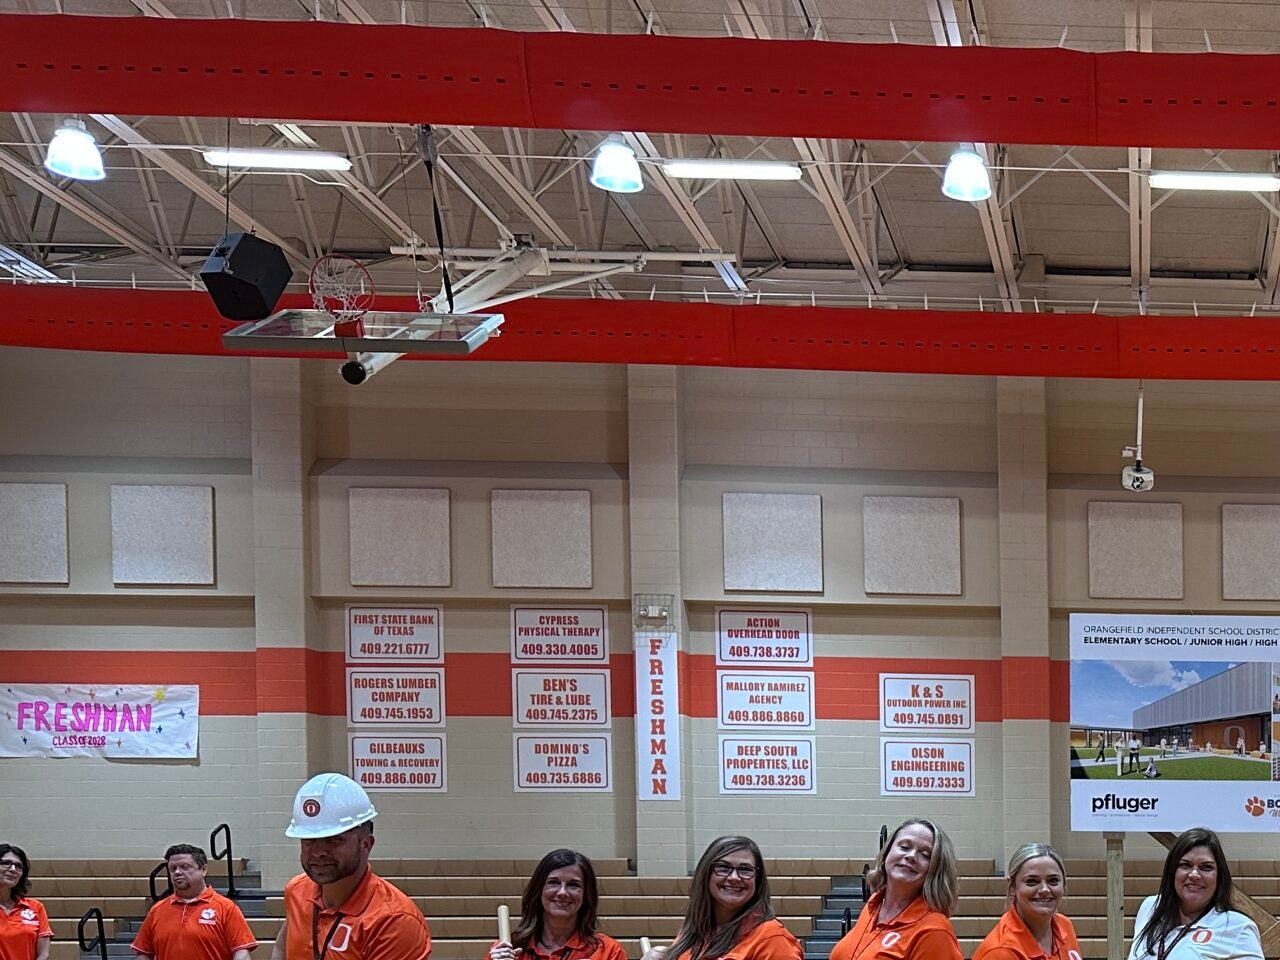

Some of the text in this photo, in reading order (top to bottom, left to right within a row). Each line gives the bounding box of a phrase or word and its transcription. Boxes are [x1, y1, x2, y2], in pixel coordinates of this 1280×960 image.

[354, 615, 434, 625] FIRST STATE BANK
[539, 615, 579, 625] CYPRESS
[746, 618, 780, 628] ACTION
[374, 626, 414, 636] OF TEXAS
[518, 627, 600, 637] PHYSICAL THERAPY
[727, 629, 800, 640] OVERHEAD DOOR
[1083, 625, 1144, 634] ORANGEFIELD
[1147, 626, 1206, 635] INDEPENDENT
[1208, 627, 1244, 635] SCHOOL
[1083, 636, 1143, 645] ELEMENTARY
[1145, 637, 1182, 645] SCHOOL
[1189, 638, 1223, 646] JUNIOR
[1225, 638, 1248, 646] HIGH
[1255, 639, 1278, 647] HIGH
[360, 643, 429, 655] 409.221.6777
[522, 643, 598, 656] 409.330.4005
[729, 645, 800, 658] 409.738.3737
[354, 678, 437, 689] ROGERS LUMBER
[543, 679, 578, 692] BEN'S
[726, 682, 805, 693] MALLORY RAMIREZ
[911, 684, 944, 698] K & S
[371, 692, 420, 702] COMPANY
[530, 694, 591, 706] TIRE & LUBE
[749, 695, 783, 705] AGENCY
[887, 699, 968, 709] OUTDOOR POWER INC.
[17, 701, 152, 732] FRESHMAN
[360, 708, 433, 719] 409.745.1953
[526, 709, 598, 720] 409.745.2375
[649, 639, 667, 795] FRESHMAN
[728, 710, 804, 722] 409.886.8860
[893, 713, 964, 725] 409.745.0891
[52, 735, 78, 746] CLASS
[369, 743, 425, 754] GILBEAUXS
[534, 743, 589, 754] DOMINO'S
[737, 745, 798, 757] DEEP SOUTH
[911, 747, 945, 759] OLSON
[355, 758, 440, 768] TOWING & RECOVERY
[547, 757, 578, 767] PIZZA
[726, 758, 809, 770] PROPERTIES, LLC
[891, 760, 965, 772] ENGINGEERING
[361, 773, 436, 784] 409.886.0007
[526, 772, 602, 784] 409.735.6886
[731, 774, 806, 786] 409.738.3236
[892, 777, 965, 788] 409.697.3333
[1092, 793, 1159, 813] pfluger
[1191, 929, 1213, 945] O
